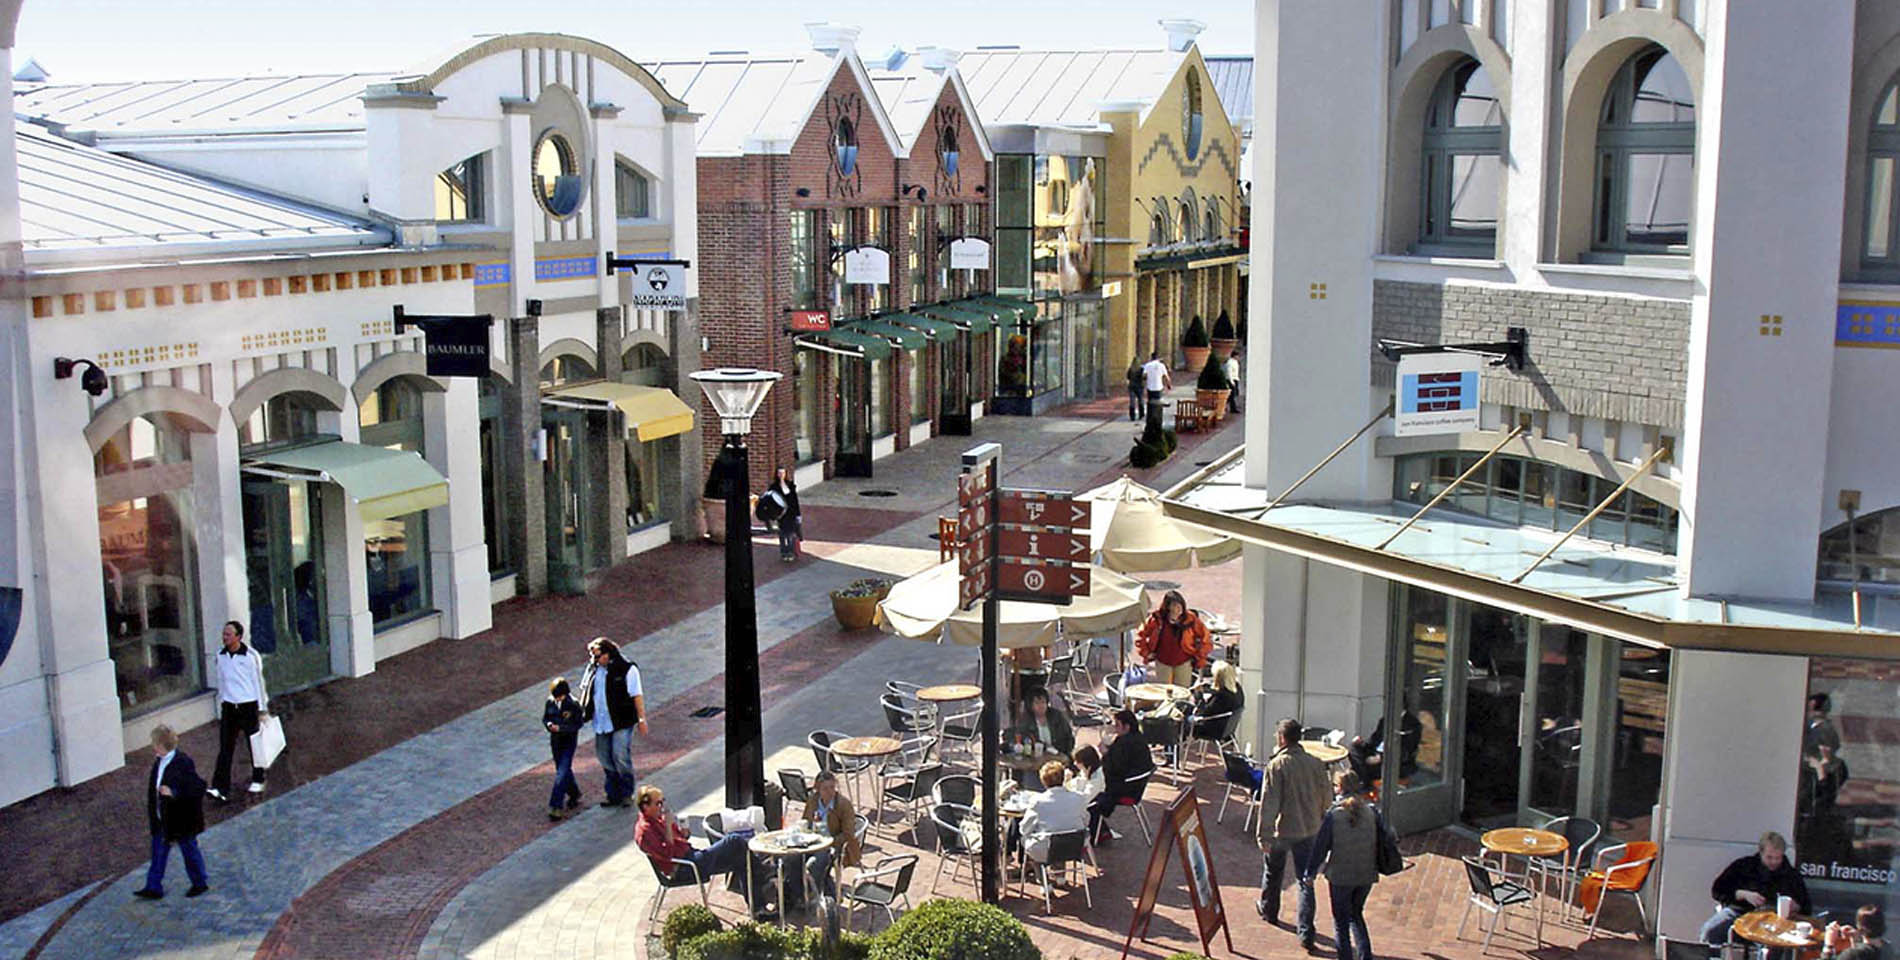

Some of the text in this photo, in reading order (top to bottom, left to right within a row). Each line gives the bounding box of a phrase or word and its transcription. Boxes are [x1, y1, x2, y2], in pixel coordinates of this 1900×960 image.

[807, 314, 825, 324] WC
[1800, 861, 1897, 883] san francisco
